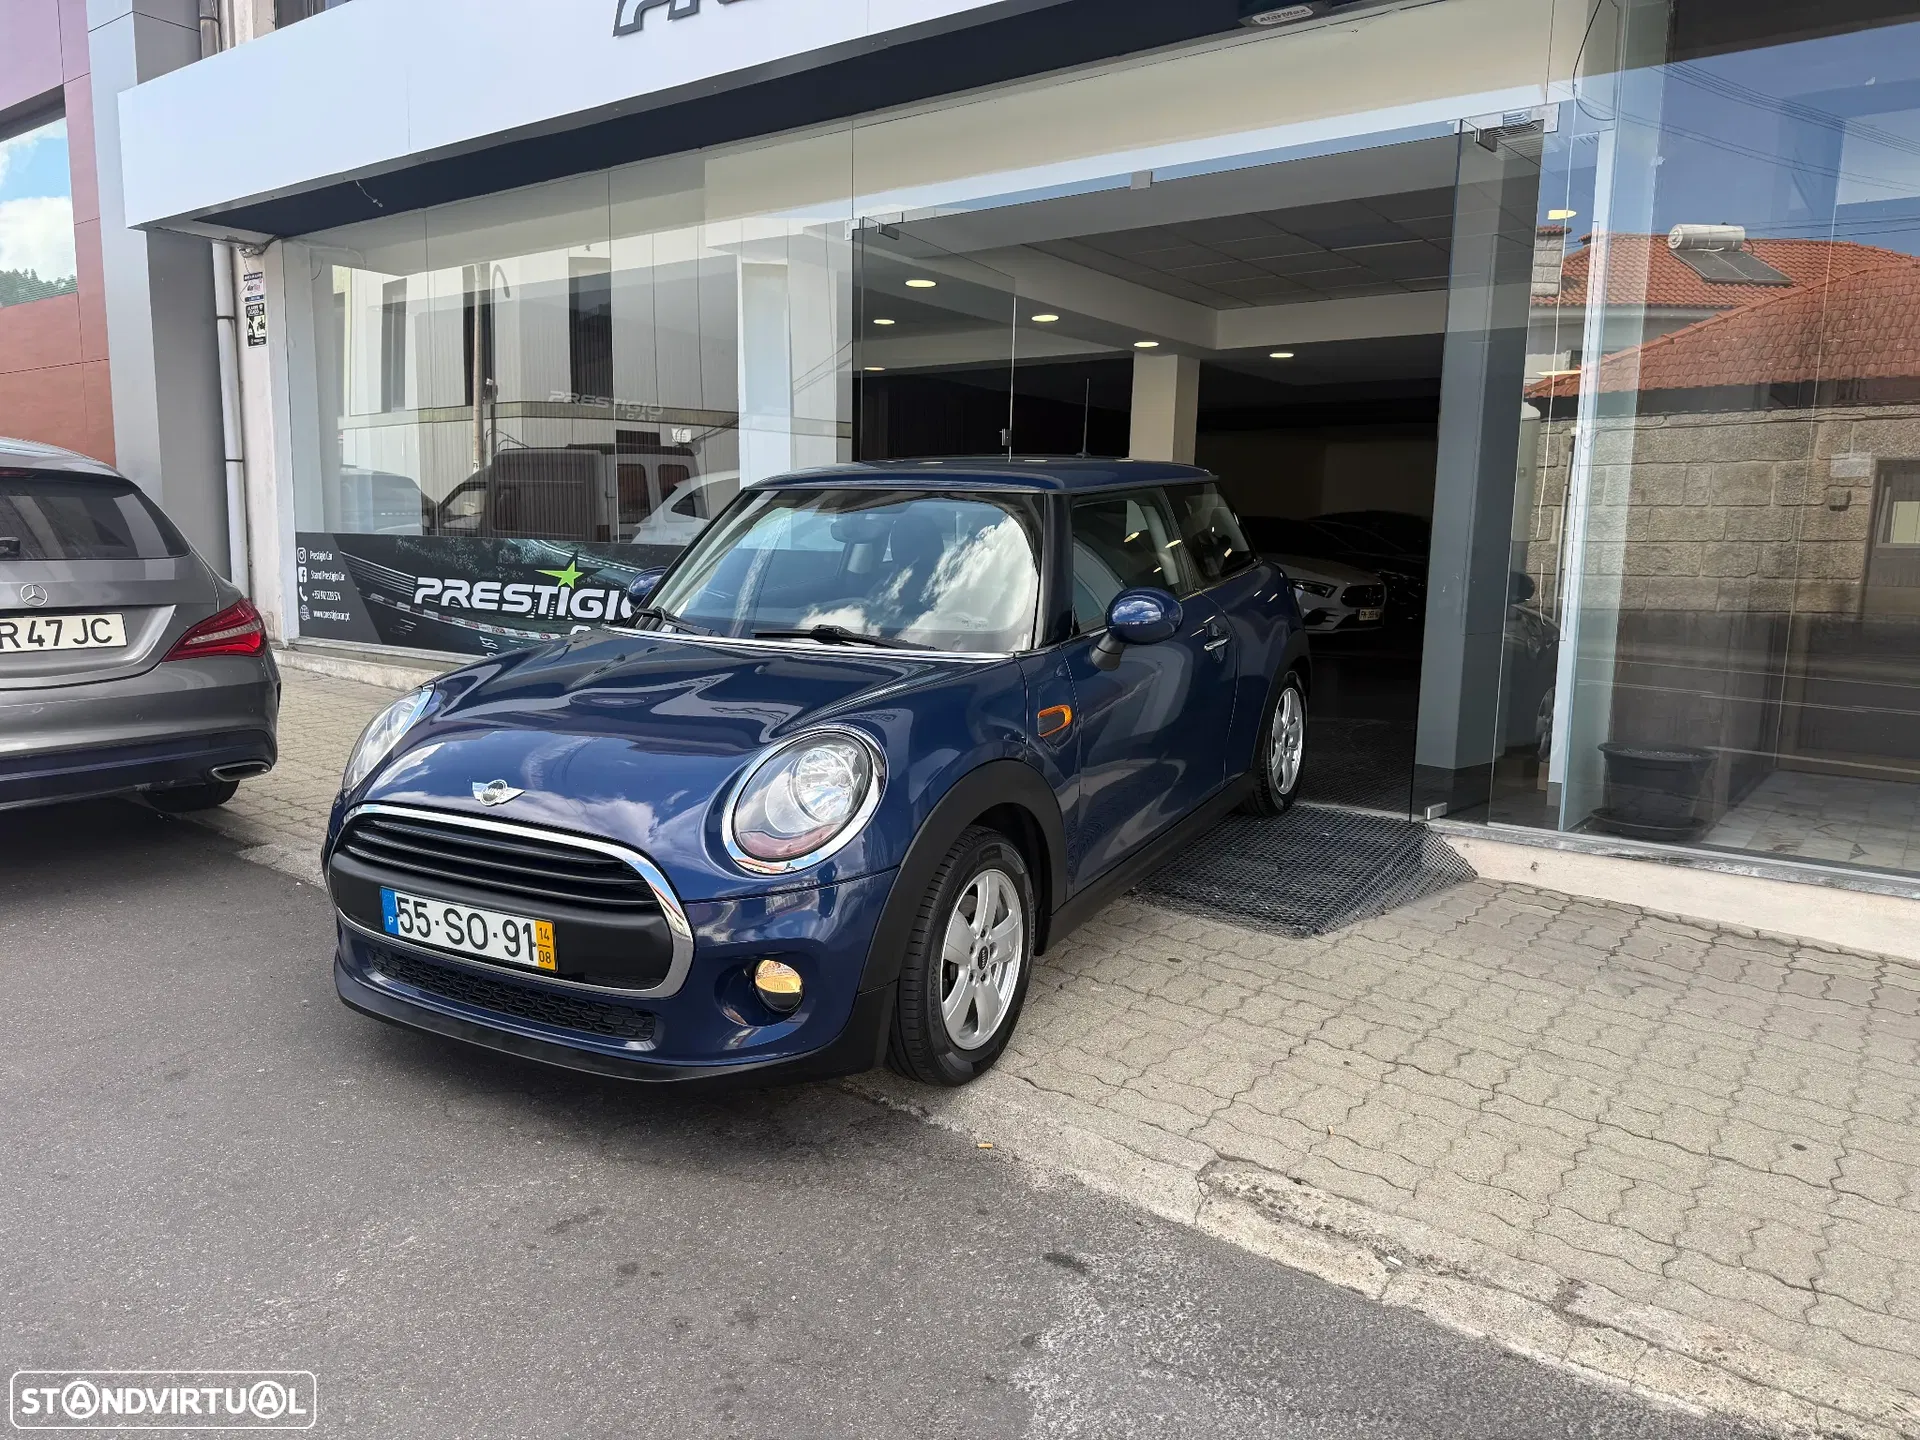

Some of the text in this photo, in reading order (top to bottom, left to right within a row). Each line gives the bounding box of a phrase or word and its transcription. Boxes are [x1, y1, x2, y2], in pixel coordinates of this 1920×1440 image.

[548, 390, 664, 416] PRESTIGIO
[626, 412, 657, 422] CAR
[27, 619, 64, 648] 47
[73, 618, 113, 645] JC
[388, 915, 395, 926] P
[539, 927, 550, 941] 14
[538, 950, 552, 964] 08
